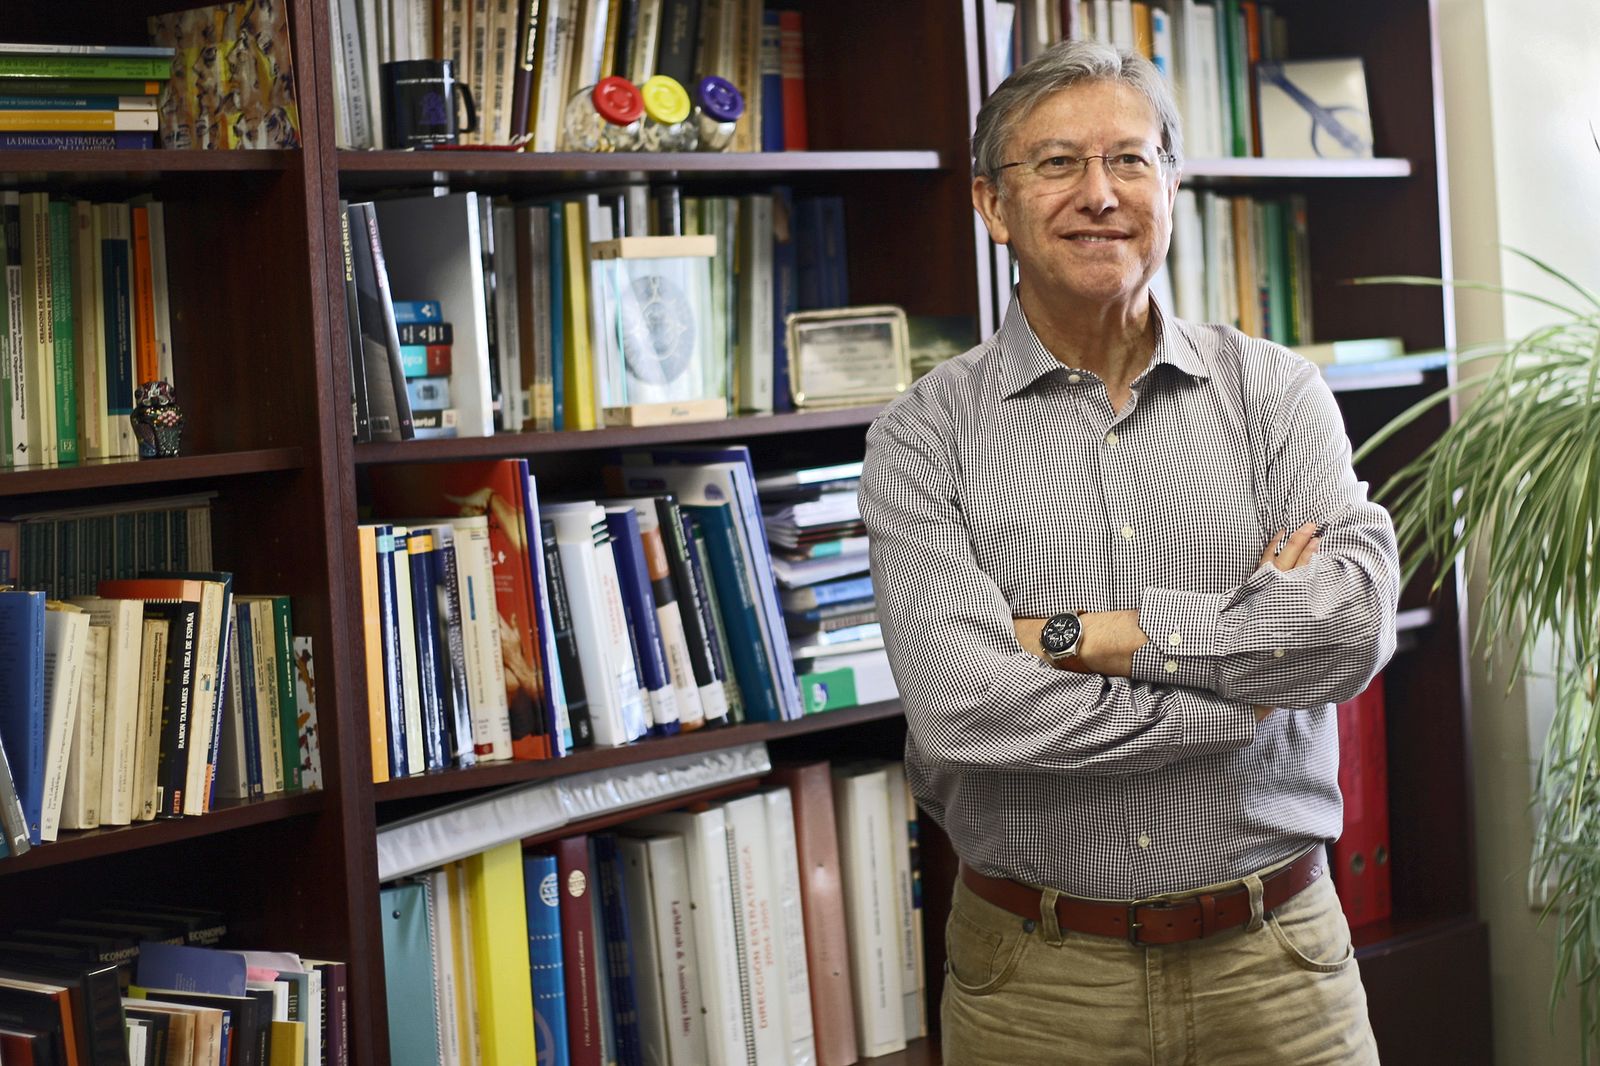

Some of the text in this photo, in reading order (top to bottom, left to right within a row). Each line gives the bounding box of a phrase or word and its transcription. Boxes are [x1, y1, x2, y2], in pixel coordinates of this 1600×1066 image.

[186, 611, 195, 639] ESPAÑA
[185, 640, 193, 650] DE
[184, 650, 192, 668] IDEA
[182, 668, 190, 685] UNA
[179, 687, 189, 722] TAMAMES
[676, 950, 685, 959] &
[677, 964, 689, 1015] Associates
